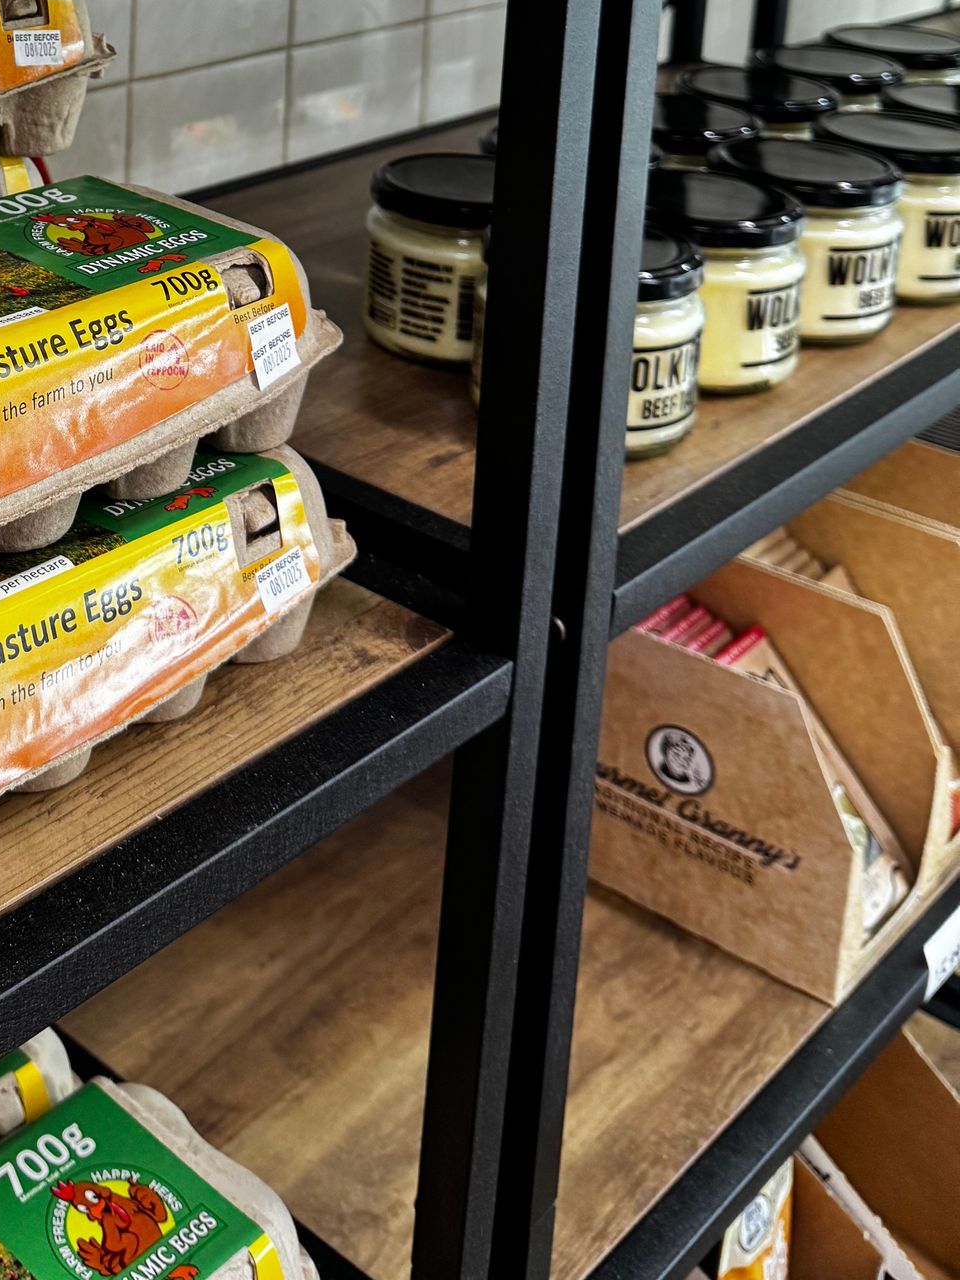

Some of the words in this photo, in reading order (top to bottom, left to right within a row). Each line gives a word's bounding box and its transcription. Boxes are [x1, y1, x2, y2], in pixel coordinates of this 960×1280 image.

[15, 33, 32, 42] BEST
[33, 33, 60, 42] BEFORE
[72, 206, 126, 216] HAPPY
[136, 212, 170, 230] HENS
[76, 243, 162, 276] DYNAMIC
[159, 229, 208, 251] EGGS
[151, 269, 219, 302] 700g
[68, 309, 134, 352] Eggs
[234, 308, 251, 325] Best
[250, 320, 265, 335] BEST
[266, 307, 289, 326] BEFORE
[253, 344, 267, 360] BEST
[268, 328, 292, 350] BEFORE
[2, 400, 27, 422] the
[31, 385, 66, 411] farm
[70, 380, 85, 396] to
[88, 367, 114, 392] you
[642, 393, 679, 420] BEEF
[189, 458, 236, 482] EGGS
[171, 522, 229, 565] 700g
[0, 577, 22, 595] per
[22, 556, 68, 582] hectare
[258, 566, 274, 584] BEST
[275, 549, 301, 572] BEFORE
[83, 577, 143, 624] Eggs
[11, 681, 36, 705] the
[40, 663, 75, 691] farm
[79, 653, 94, 672] to
[97, 639, 122, 667] you
[52, 1198, 69, 1245] FRESH
[90, 1168, 141, 1184] HAPPY
[147, 1179, 182, 1213] HENS
[175, 1210, 218, 1256] EGGS
